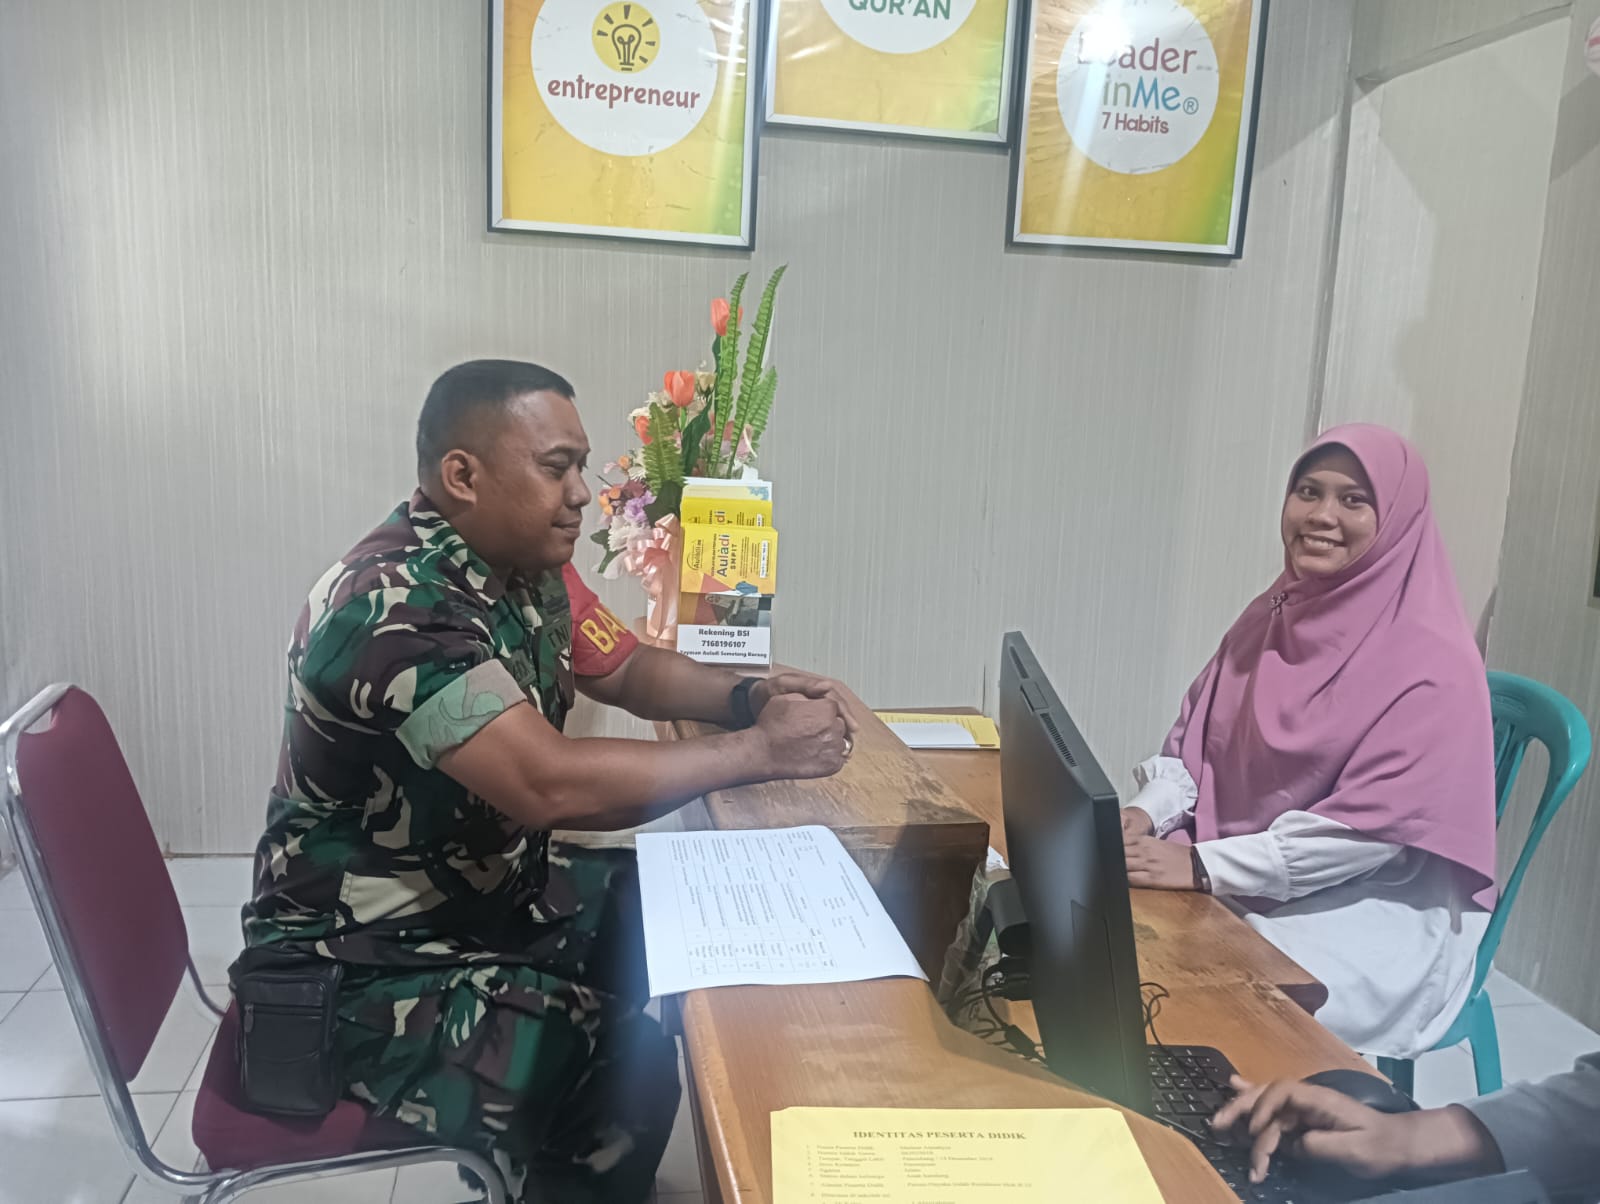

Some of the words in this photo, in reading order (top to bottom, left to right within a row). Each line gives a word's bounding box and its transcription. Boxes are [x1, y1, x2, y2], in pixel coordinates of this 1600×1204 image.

[848, 0, 951, 20] QUR'AN
[1078, 32, 1198, 74] Lader
[548, 74, 700, 108] entrepreneur
[1101, 112, 1111, 129] 7
[1115, 112, 1169, 134] Habits
[580, 607, 627, 654] BA
[698, 628, 735, 638] Rekening
[854, 1131, 924, 1139] IDENTITAS
[926, 1131, 985, 1139] PESERTA
[988, 1132, 1027, 1140] DIDIK
